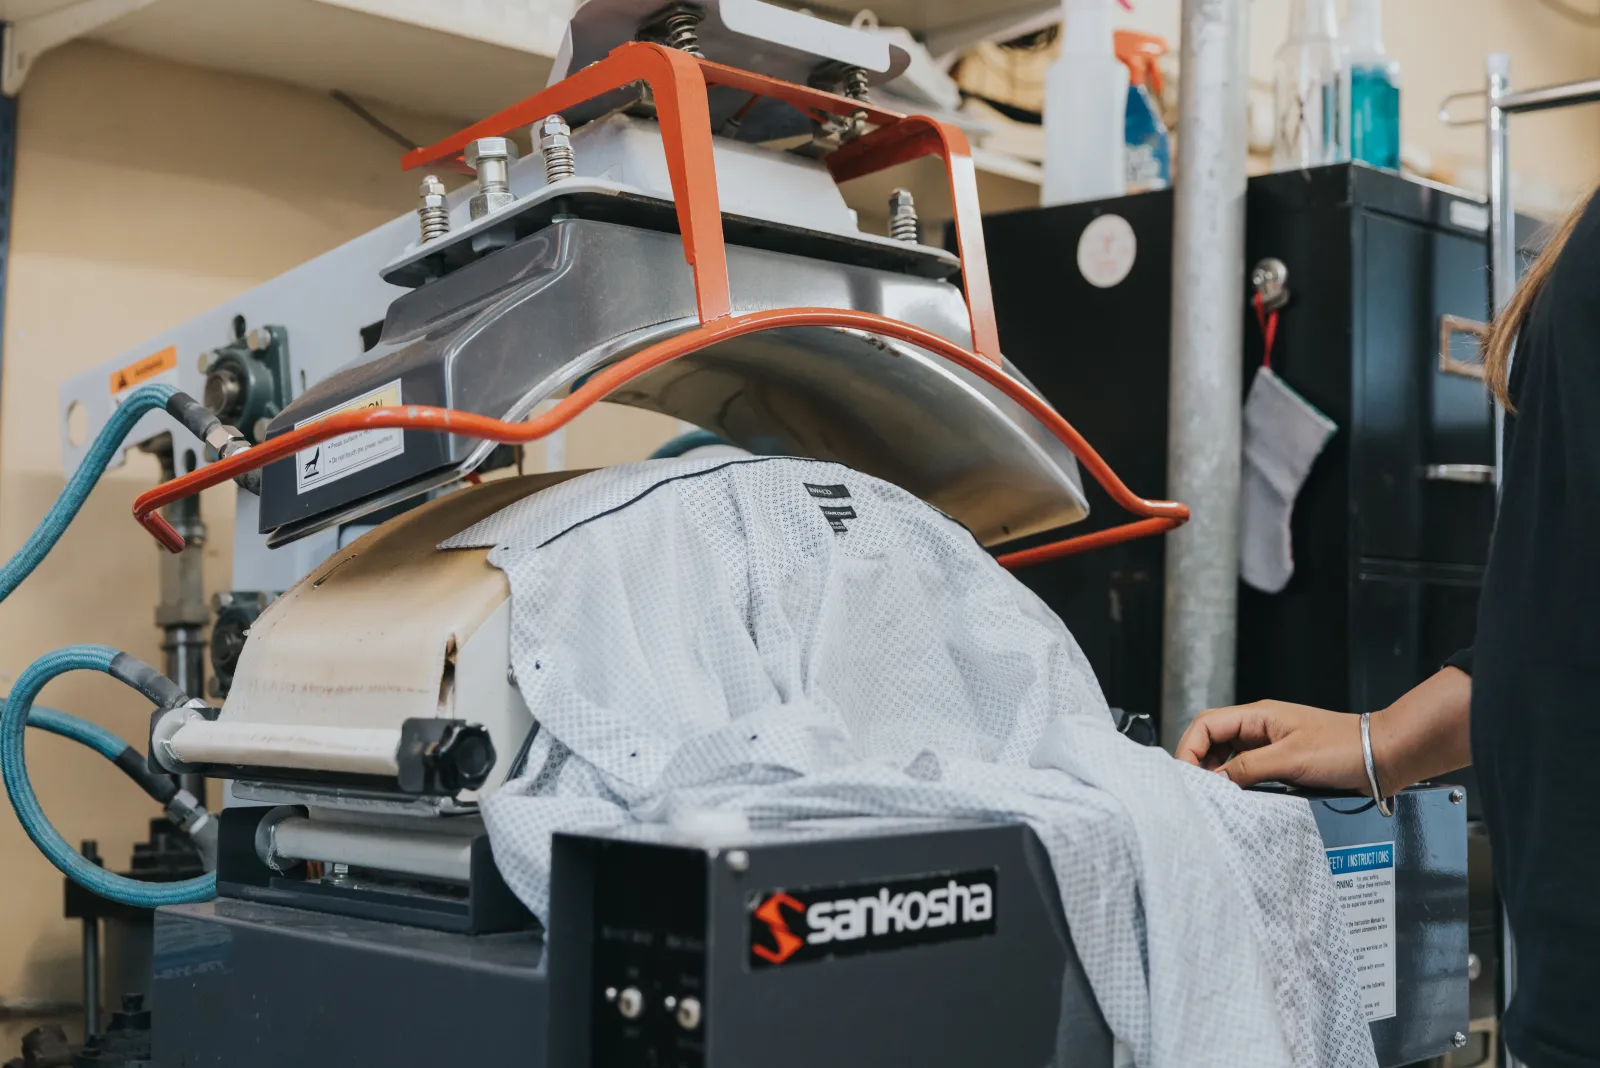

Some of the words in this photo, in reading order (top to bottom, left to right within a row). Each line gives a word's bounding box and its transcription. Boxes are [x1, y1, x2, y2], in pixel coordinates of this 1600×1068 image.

[345, 449, 358, 460] touch
[1328, 855, 1344, 870] FETY
[1347, 850, 1389, 868] INSTRUCTIONS
[1336, 879, 1354, 890] RNING
[806, 880, 993, 945] sankosha
